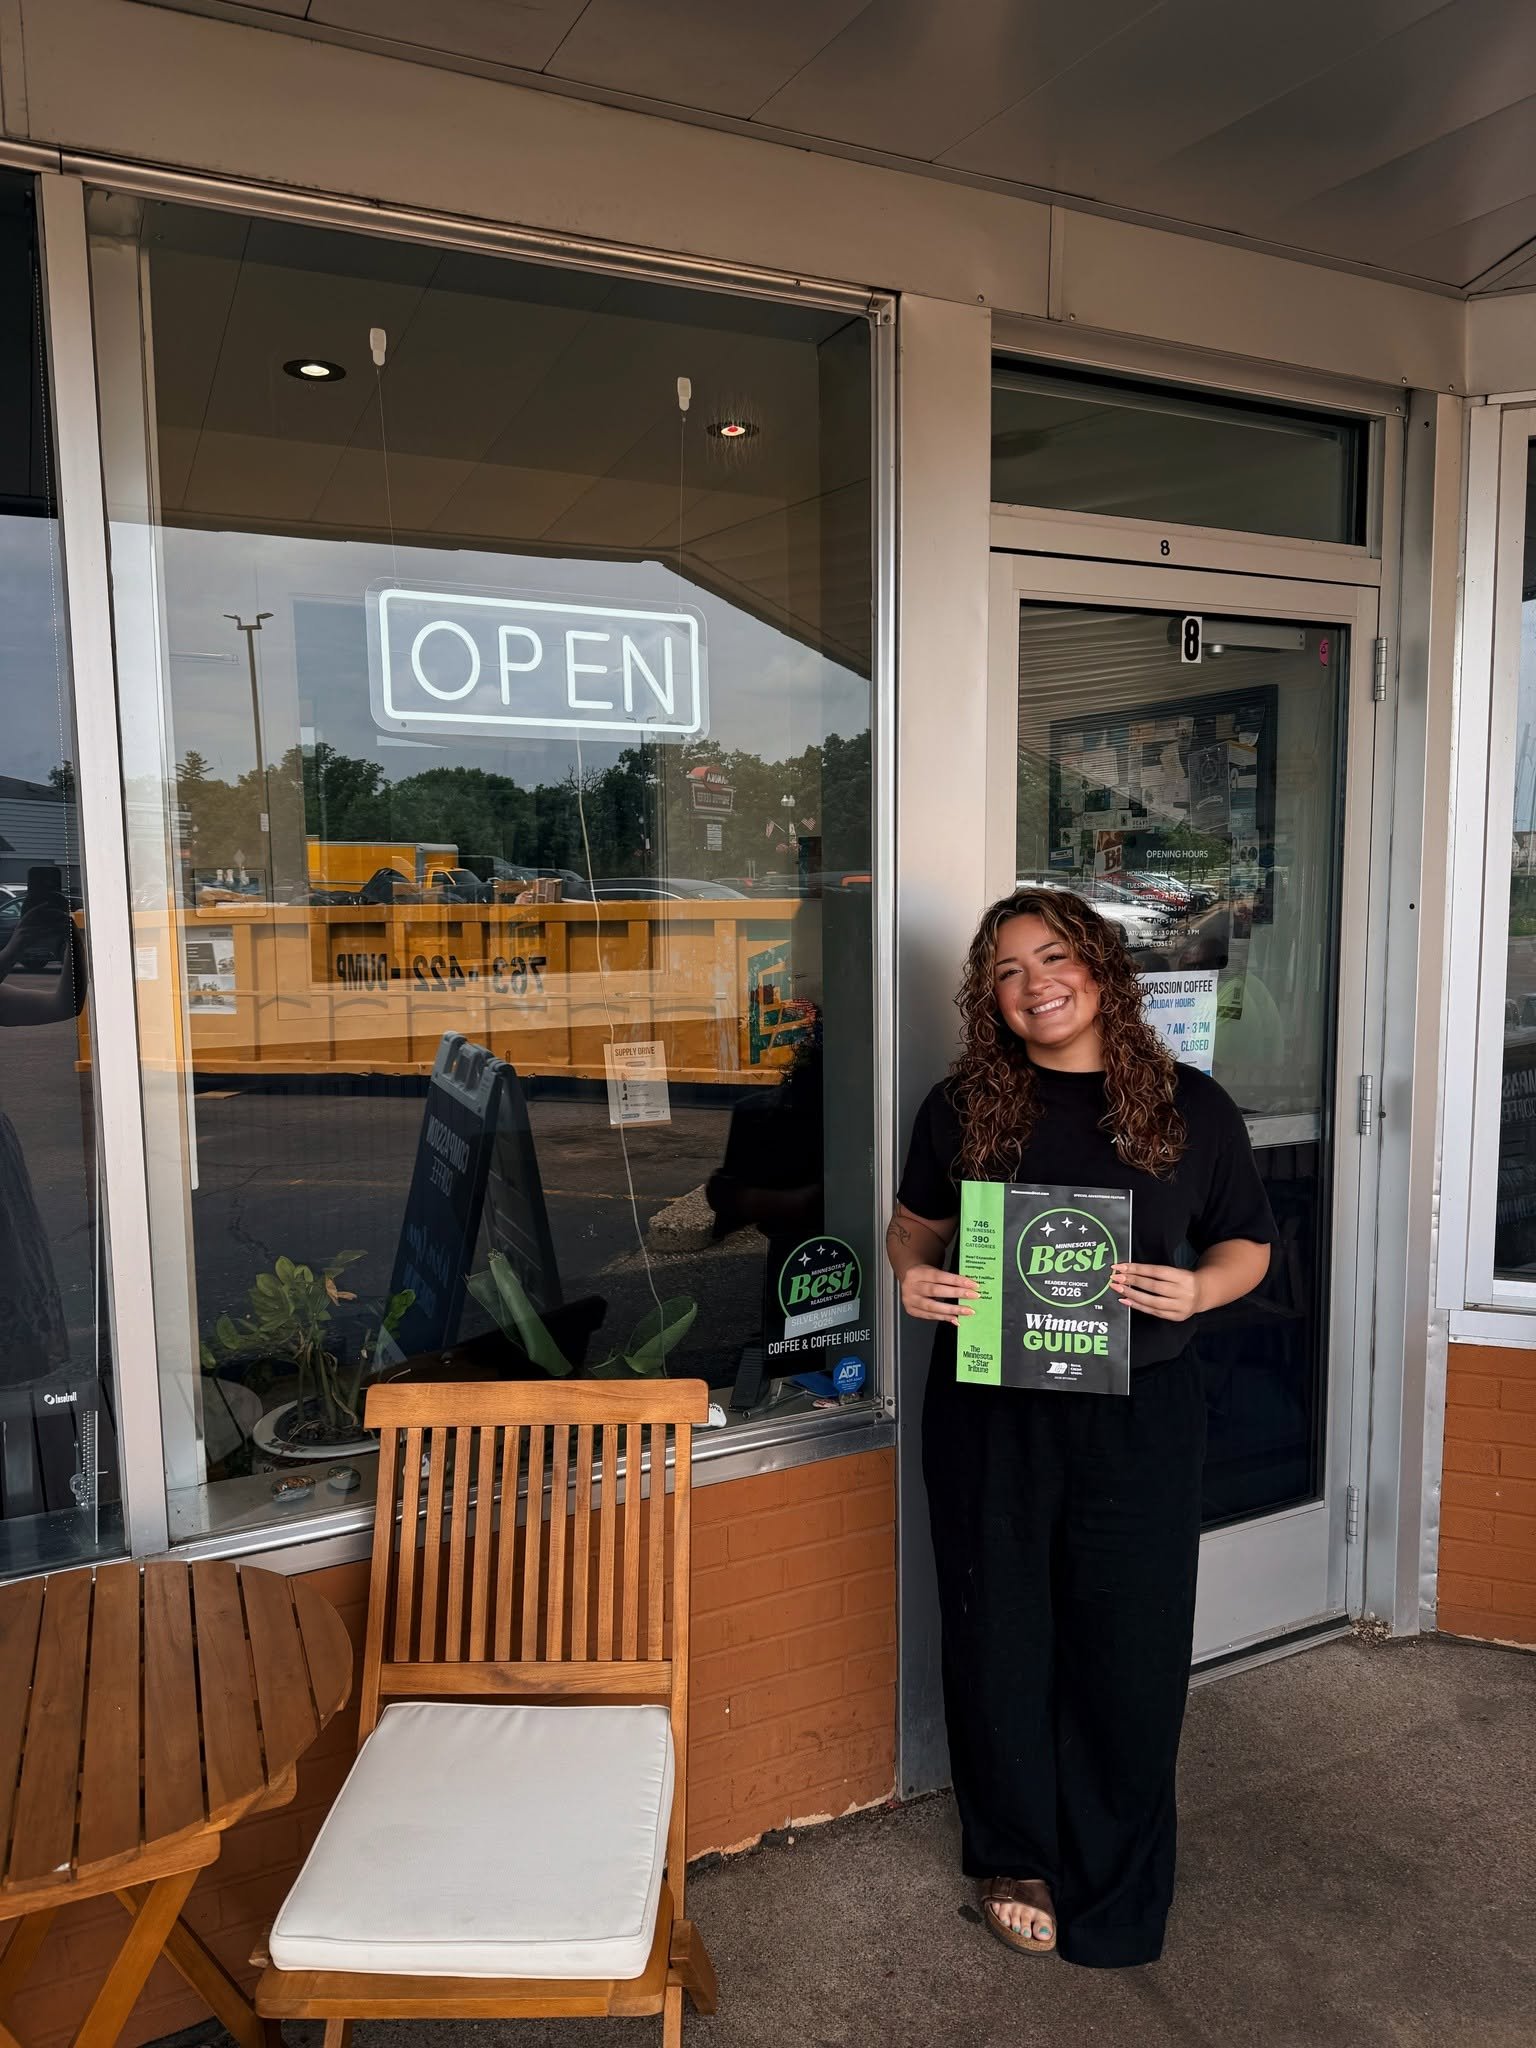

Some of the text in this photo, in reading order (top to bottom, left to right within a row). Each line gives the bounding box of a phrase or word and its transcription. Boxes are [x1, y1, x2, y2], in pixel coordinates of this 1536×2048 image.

[1160, 540, 1170, 556] 8
[1184, 618, 1200, 661] 8
[411, 620, 674, 715] OPEN
[1146, 850, 1208, 859] OPENING HOURS
[1150, 940, 1173, 948] CLOSED
[1184, 980, 1213, 993] COFFEE
[1149, 998, 1196, 1009] HOLIDAY HOURS
[1166, 1024, 1171, 1035] 7
[1173, 1023, 1185, 1034] AM
[1192, 1022, 1197, 1033] 3
[1198, 1022, 1210, 1033] PM
[615, 1046, 655, 1057] SUPPLY DRIVE
[1180, 1039, 1209, 1052] CLOSED
[973, 1220, 989, 1228] 746
[972, 1235, 989, 1243] 390
[1055, 1241, 1097, 1249] MINNESOTA'S
[1026, 1241, 1109, 1276] Best
[811, 1262, 845, 1275] MINNESOTA'S
[787, 1261, 856, 1306] Best
[833, 1290, 852, 1301] CHOICE
[1051, 1286, 1082, 1298] 2026
[791, 1304, 853, 1327] SILVER WINNER
[1025, 1313, 1109, 1334] Winners
[768, 1328, 871, 1355] COFFEE & COFFEE HOUSE
[1023, 1332, 1109, 1356] GUIDE
[963, 1351, 993, 1360] Minnesota
[970, 1345, 980, 1353] The
[838, 1364, 862, 1379] ADT
[967, 1364, 989, 1374] Tribune
